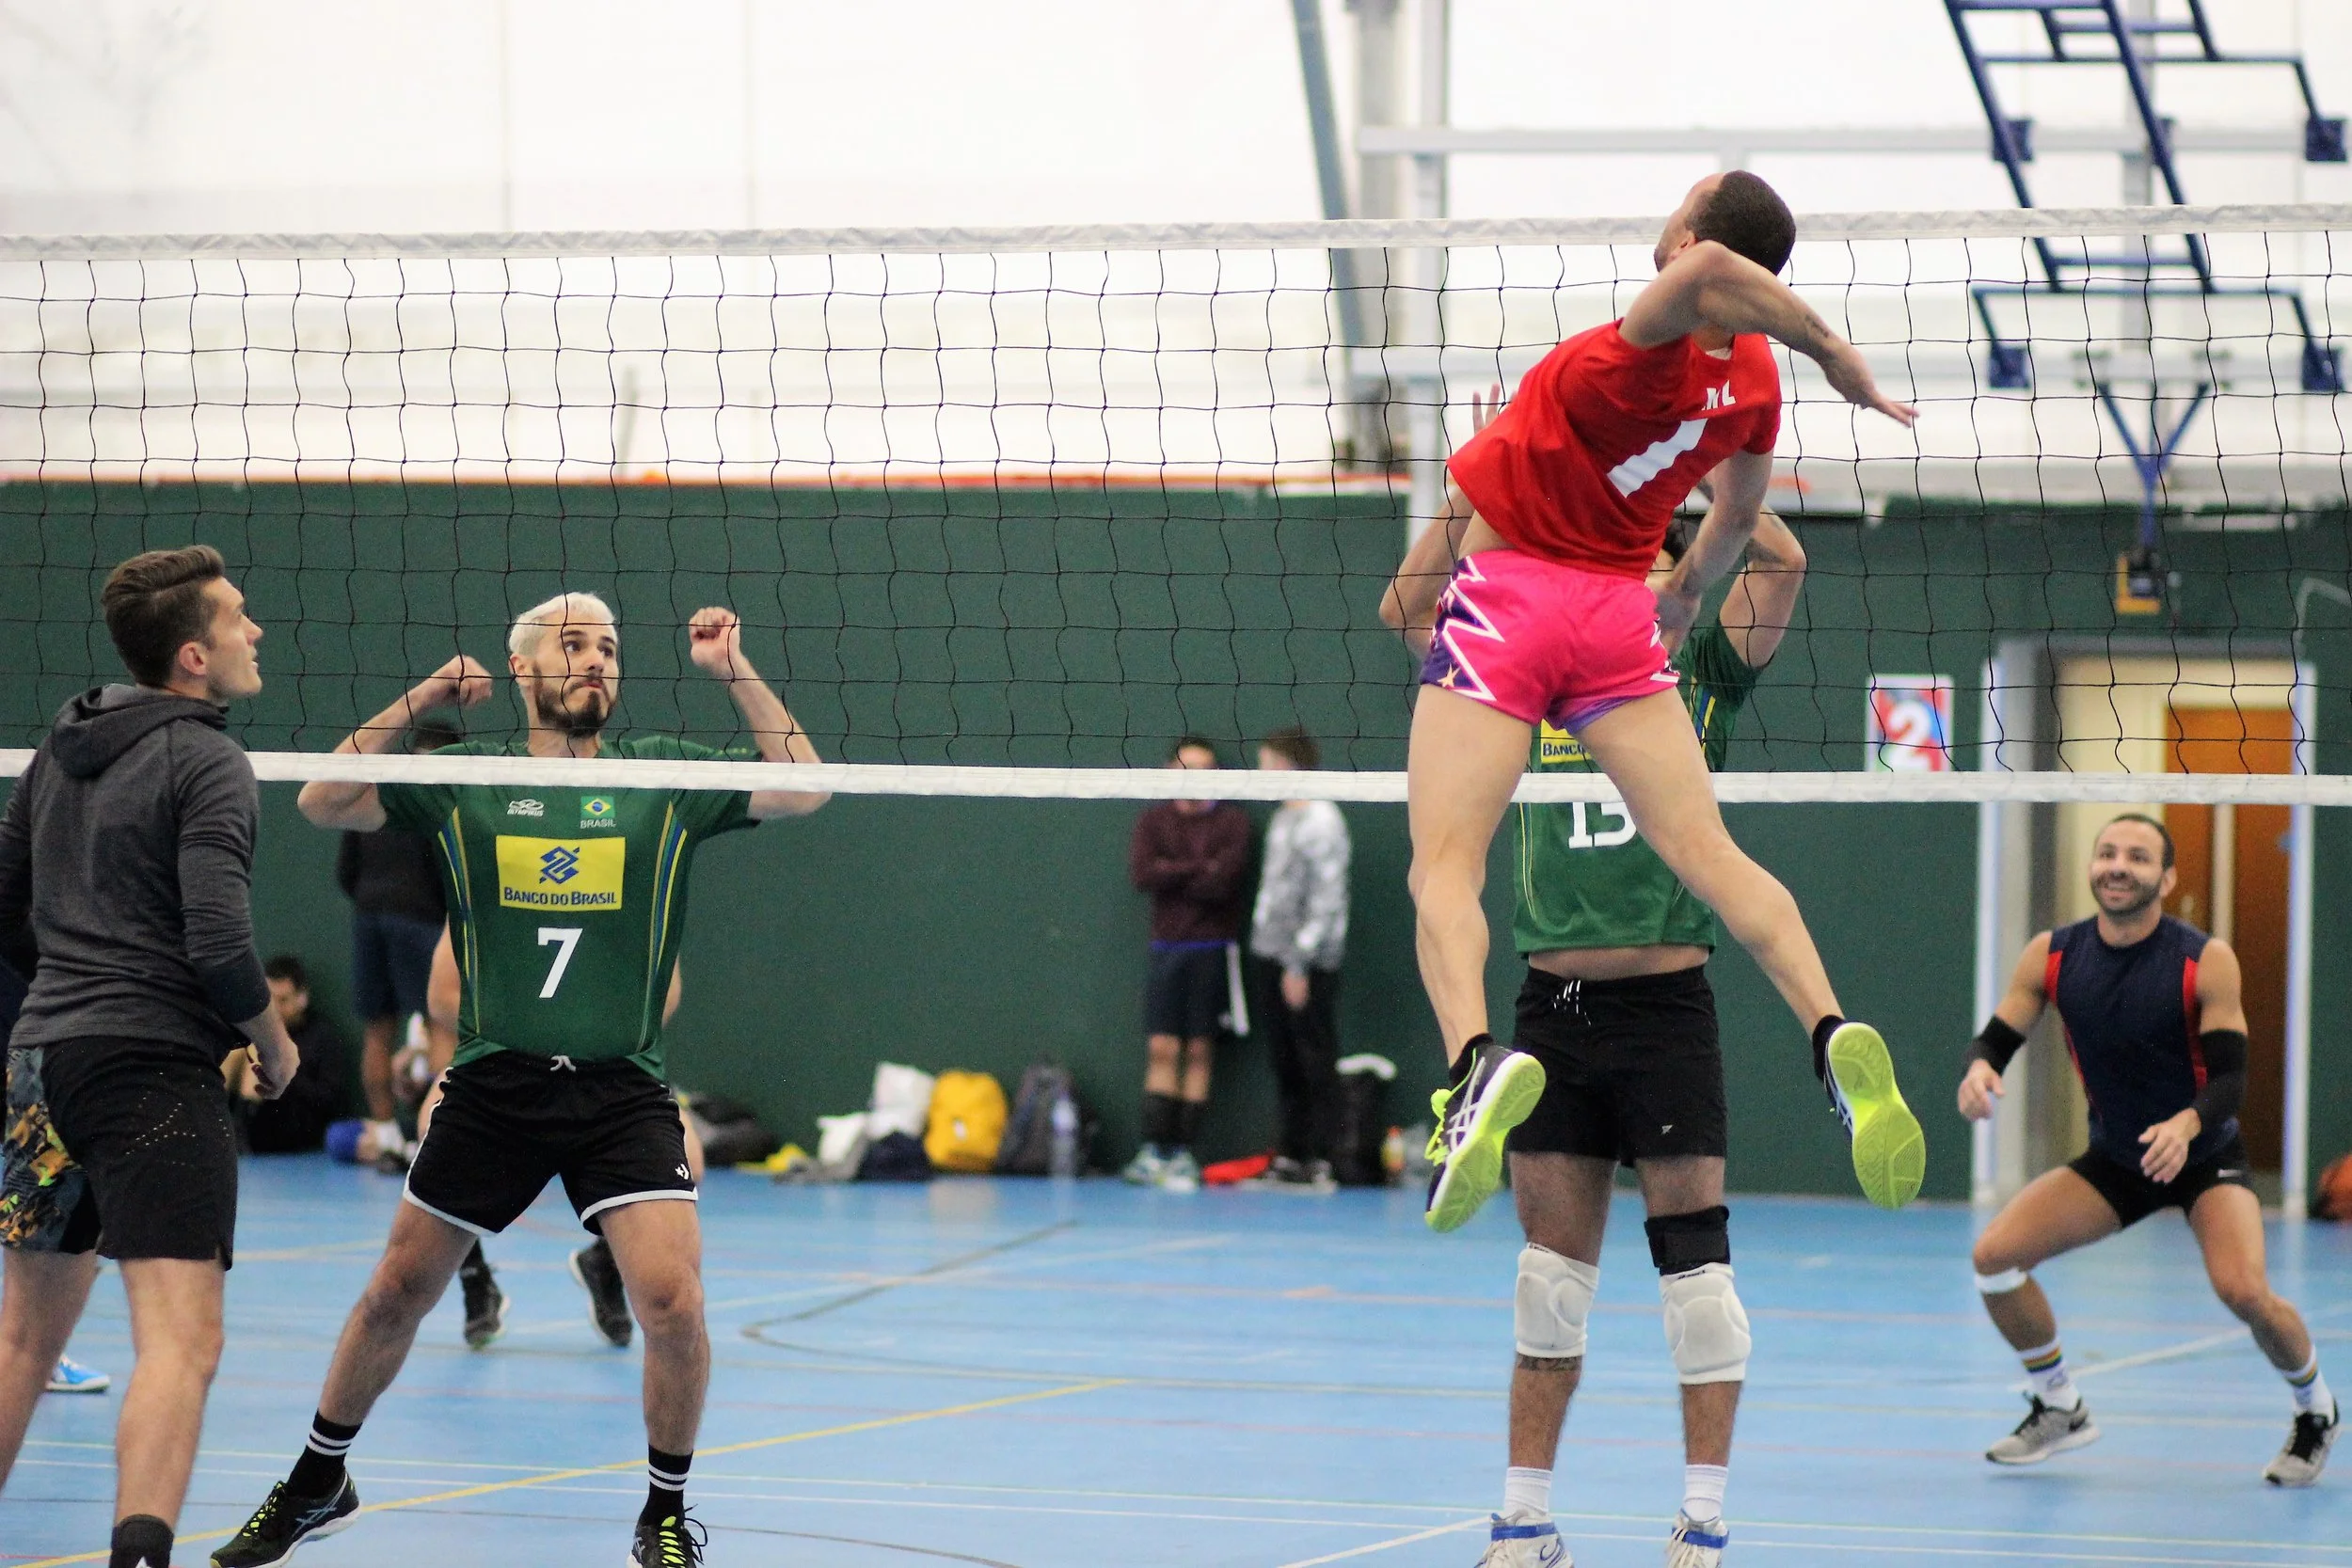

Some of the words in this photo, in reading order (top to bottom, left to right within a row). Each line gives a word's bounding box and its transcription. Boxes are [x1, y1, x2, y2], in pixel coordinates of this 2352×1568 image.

[1607, 419, 1708, 498] 1
[1888, 699, 1931, 771] 2
[580, 818, 616, 829] BRASIL
[1568, 802, 1637, 848] 15
[504, 887, 548, 904] BANCO
[550, 894, 568, 905] DO
[571, 891, 617, 905] BRASIL
[537, 927, 583, 998] 7
